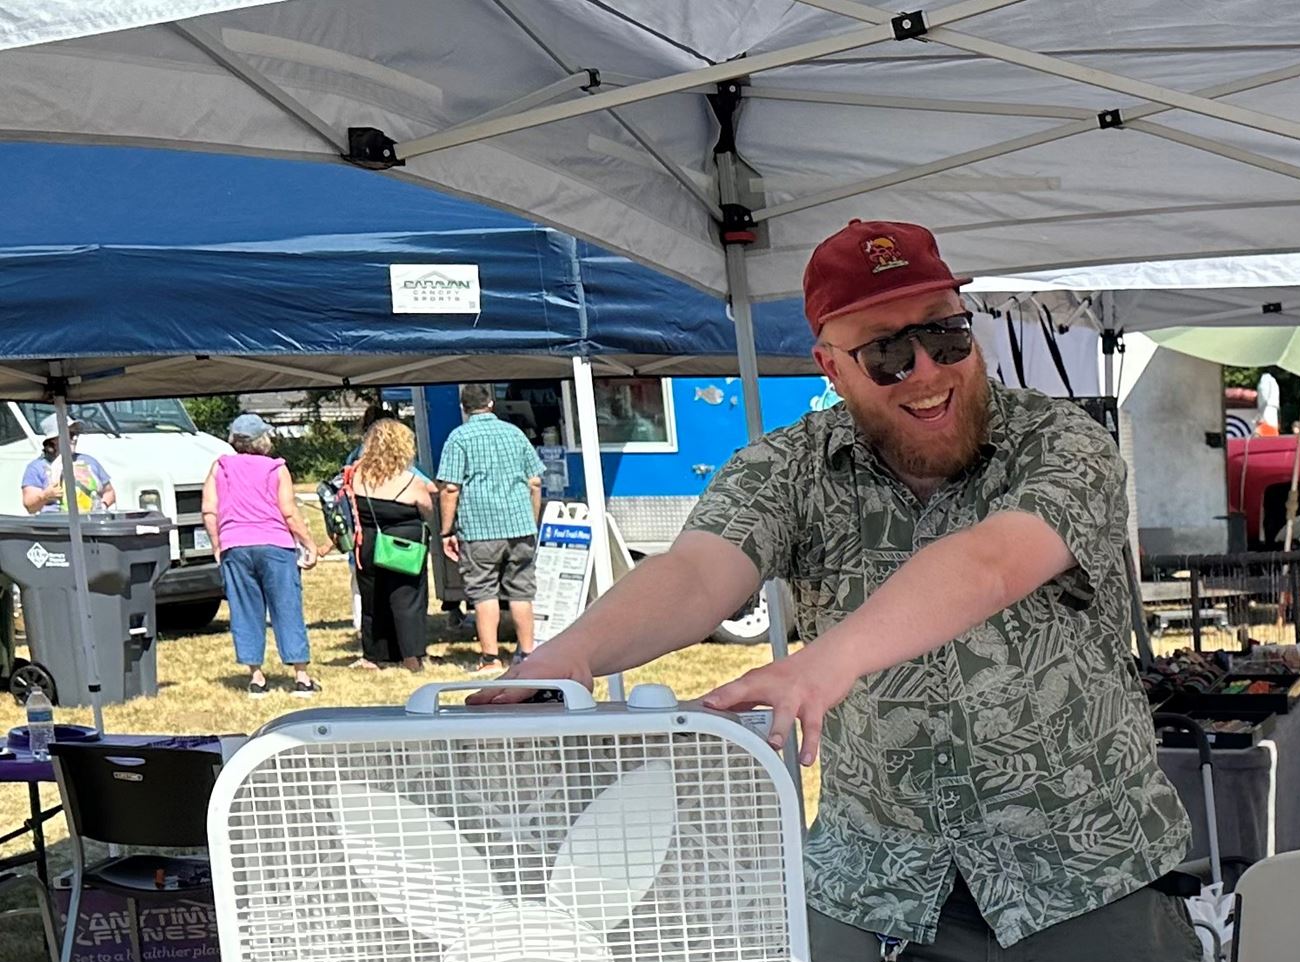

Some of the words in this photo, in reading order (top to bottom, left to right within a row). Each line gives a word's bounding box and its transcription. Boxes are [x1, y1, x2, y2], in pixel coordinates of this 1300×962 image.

[98, 952, 111, 962] to
[114, 954, 124, 962] a
[127, 945, 192, 962] halthier
[192, 943, 220, 959] pla
